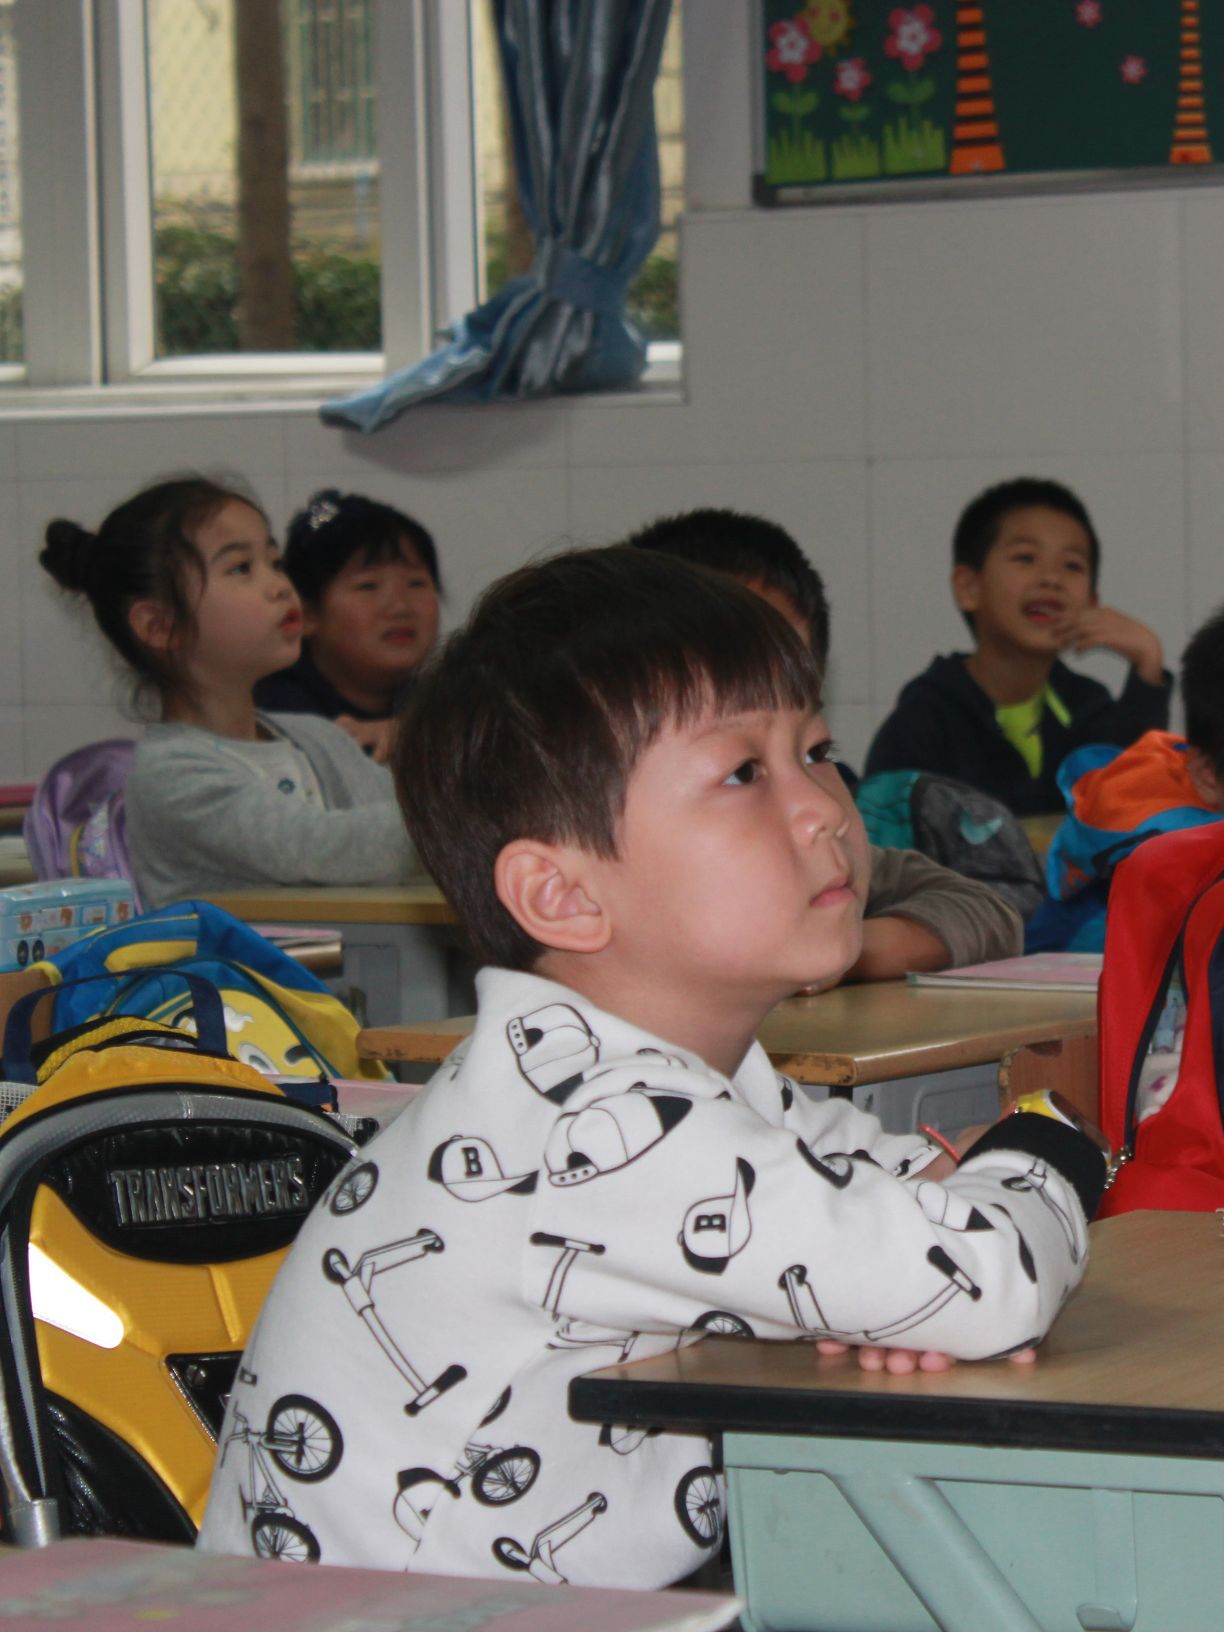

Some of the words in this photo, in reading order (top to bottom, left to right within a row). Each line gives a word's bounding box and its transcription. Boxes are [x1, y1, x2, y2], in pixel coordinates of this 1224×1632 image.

[461, 1146, 483, 1178] B
[107, 1154, 308, 1226] TRANSFORMERS
[693, 1213, 726, 1233] B
